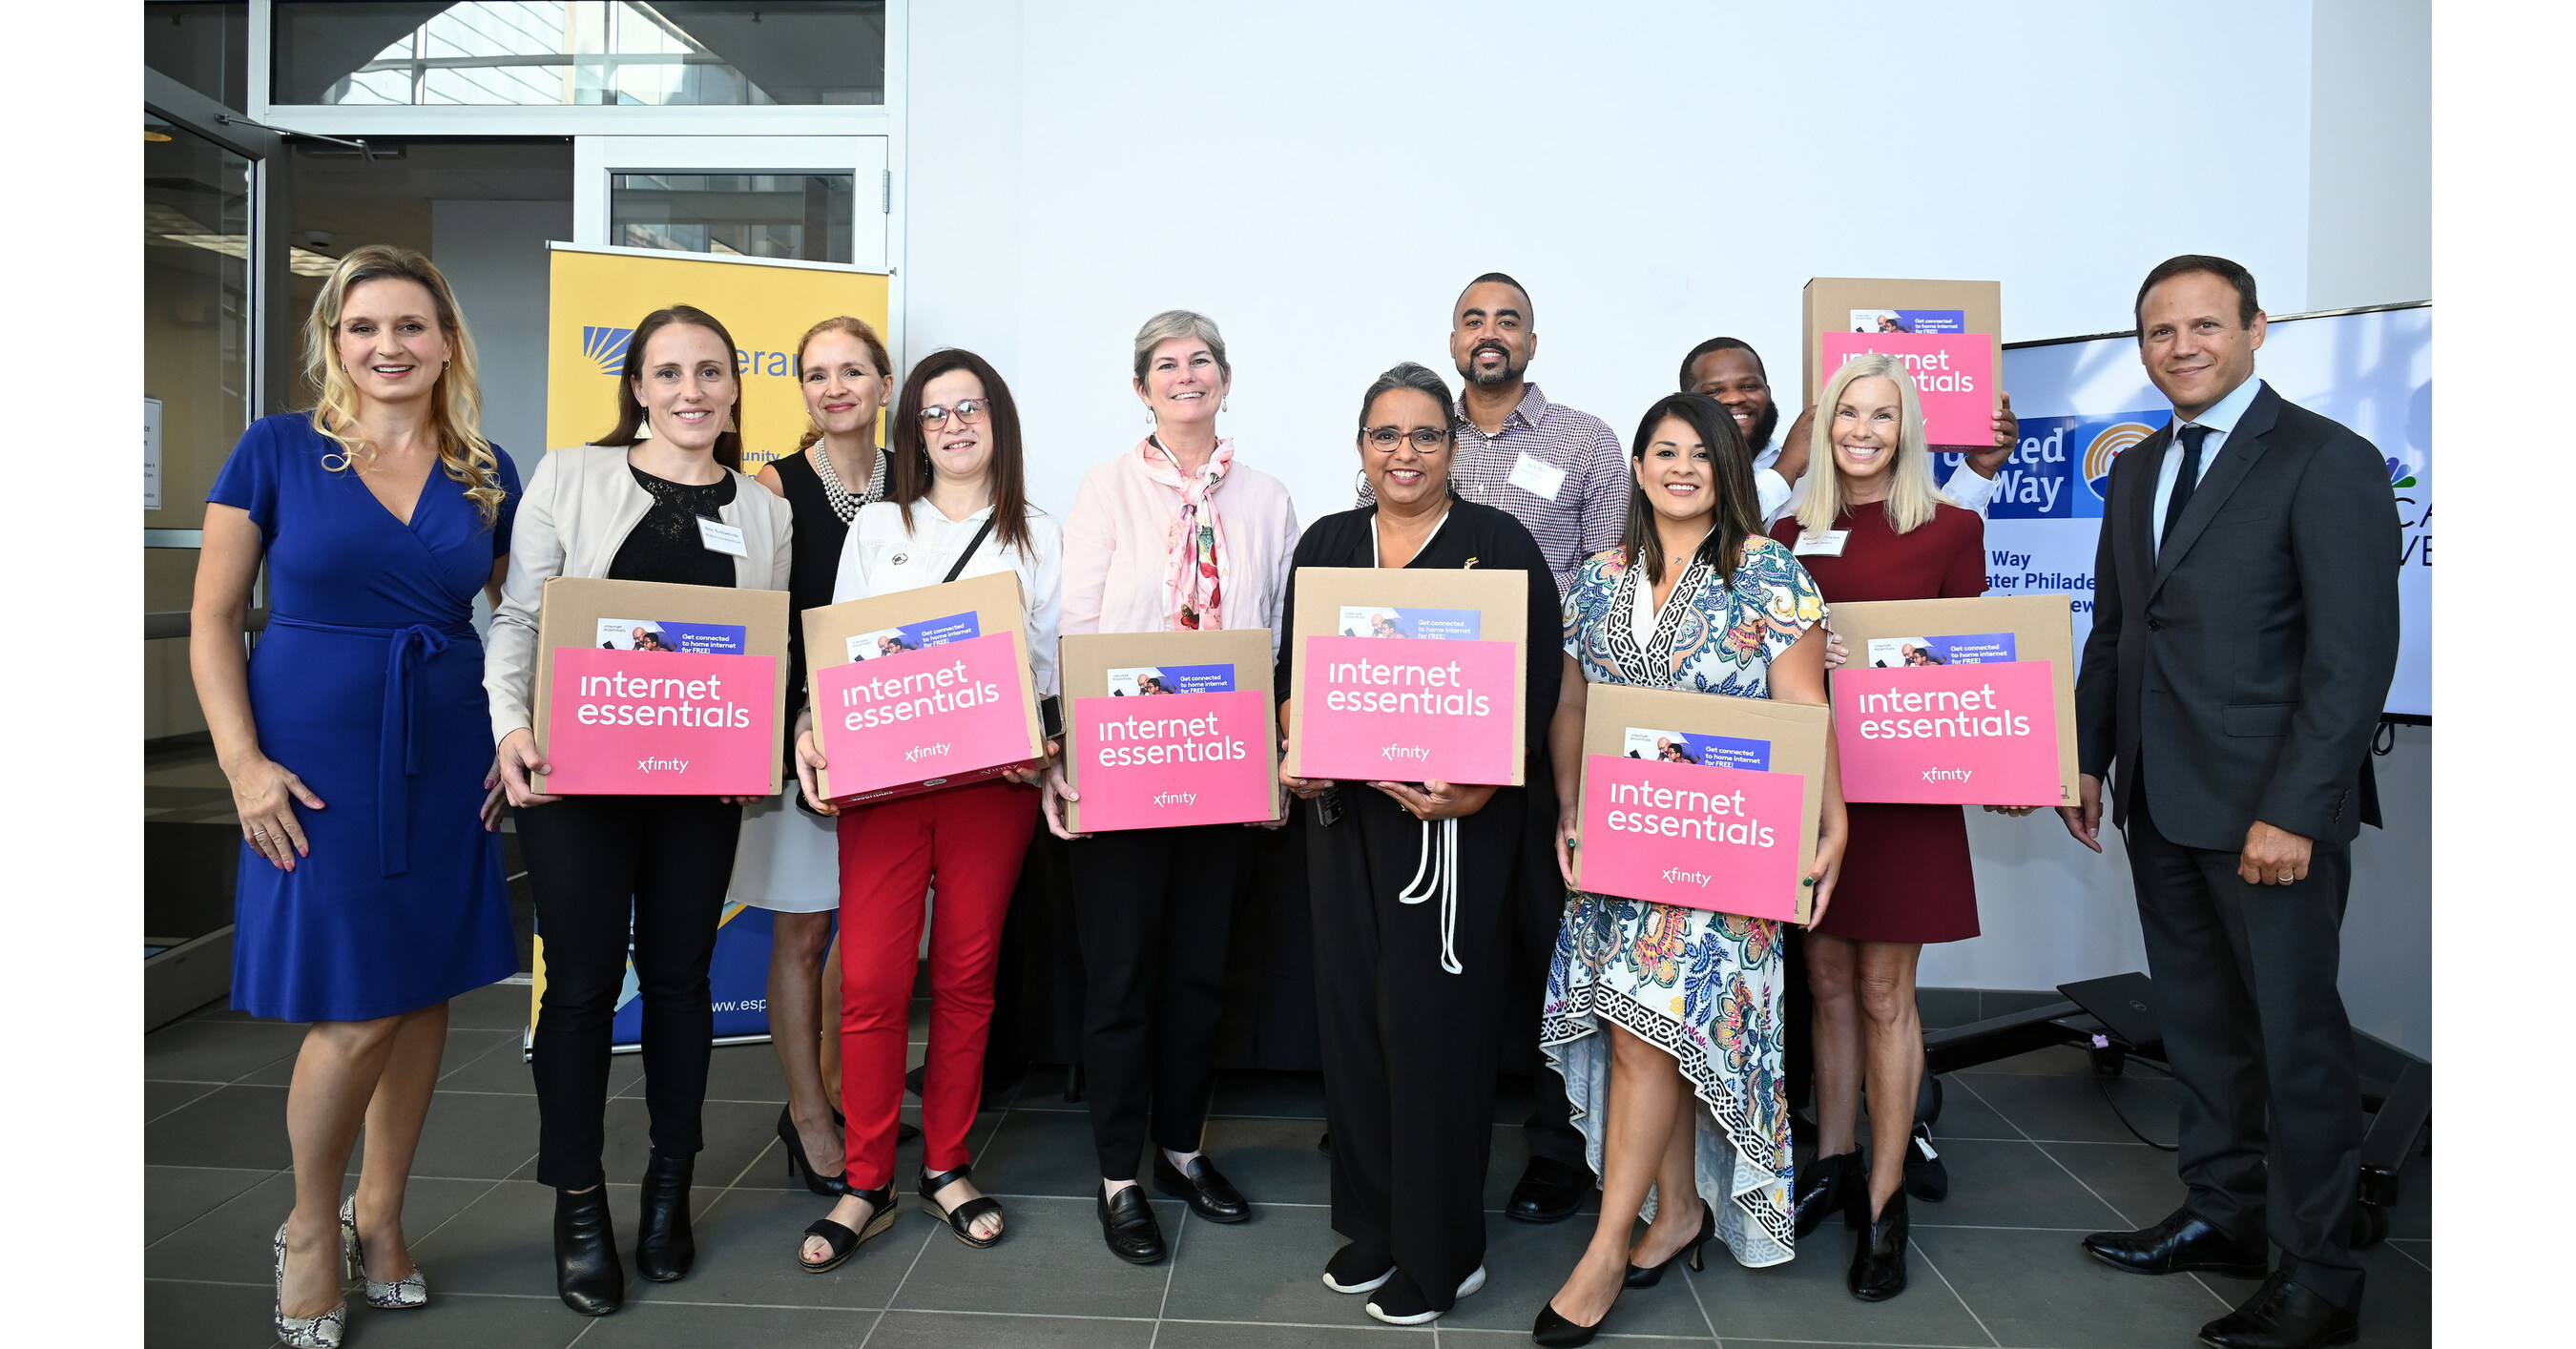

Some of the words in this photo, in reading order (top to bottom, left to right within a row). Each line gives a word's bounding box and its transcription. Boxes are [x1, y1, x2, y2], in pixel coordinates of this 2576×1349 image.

[736, 349, 798, 377] era
[1842, 348, 1950, 370] inet
[1909, 370, 1974, 392] tials
[1992, 470, 2064, 512] Way
[1992, 550, 2031, 571] Way
[2025, 572, 2095, 590] Philade
[930, 633, 946, 641] home
[947, 628, 971, 637] internet
[934, 623, 965, 634] connected
[843, 659, 967, 708] internet
[1330, 657, 1460, 687] internet
[580, 670, 720, 700] internet
[845, 680, 1000, 731] essentials
[1327, 687, 1490, 716] essentials
[1859, 683, 1996, 714] internet
[577, 700, 750, 728] essentials
[1099, 711, 1218, 741] internet
[1860, 710, 2030, 739] essentials
[905, 742, 951, 762] xfinity
[1099, 736, 1246, 767] essentials
[1381, 743, 1430, 761] xfinity
[1719, 748, 1754, 757] connected
[1734, 756, 1760, 764] internet
[637, 756, 689, 774] xfinity
[1922, 767, 1972, 783] xfinity
[1153, 791, 1196, 807] xfinity
[1610, 779, 1745, 817] internet
[1608, 810, 1775, 848] essentials
[1662, 867, 1712, 887] xfinity
